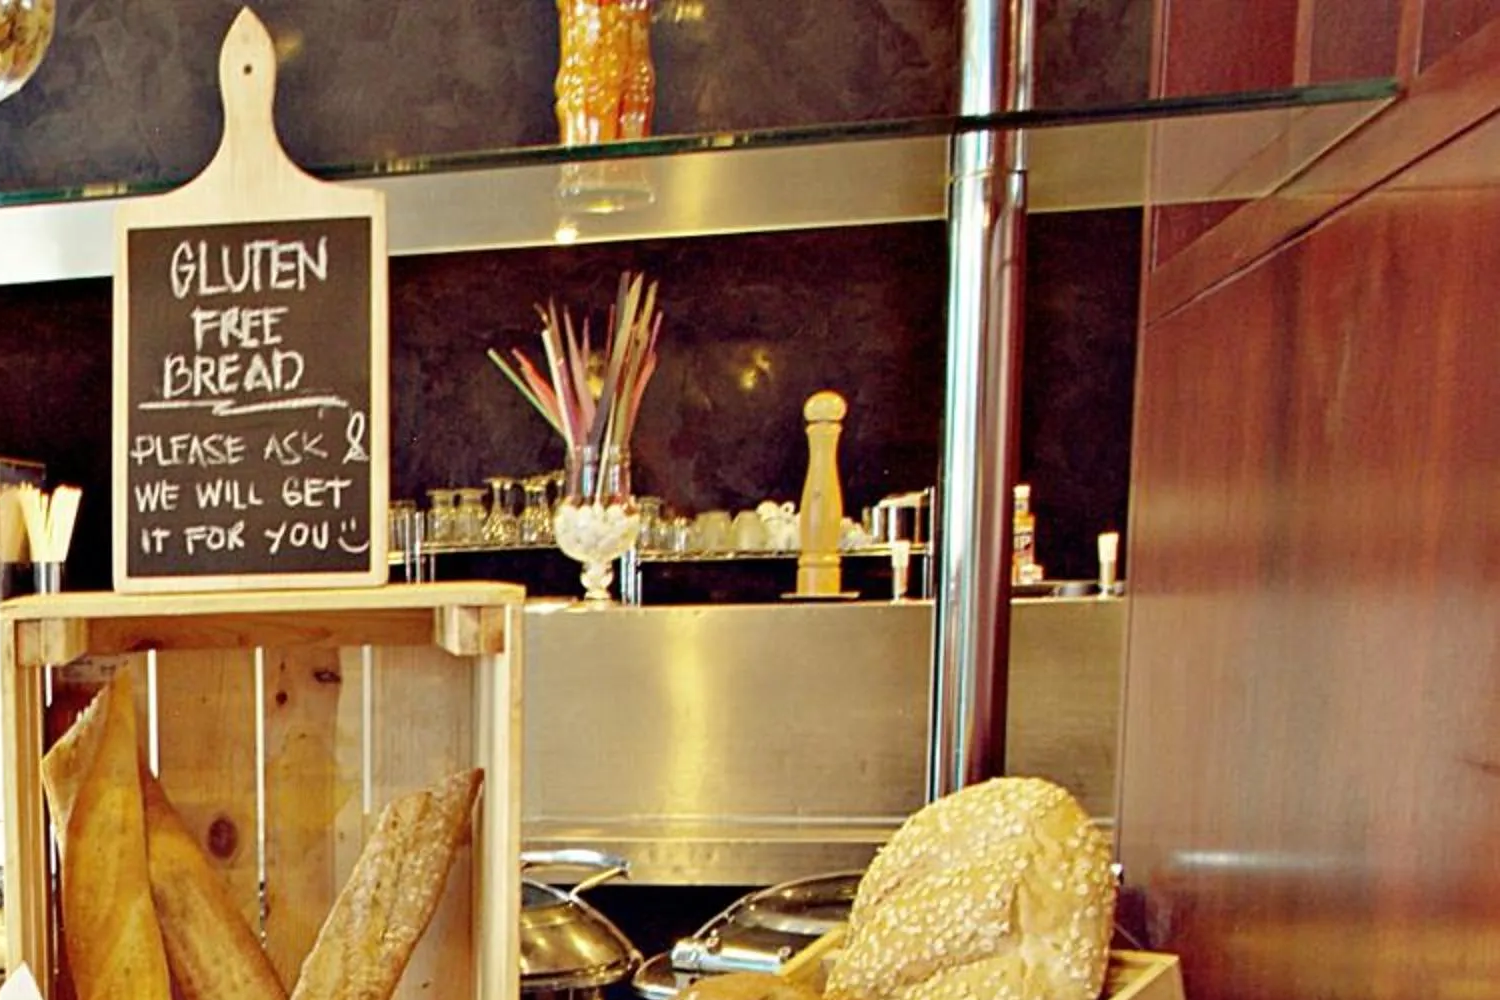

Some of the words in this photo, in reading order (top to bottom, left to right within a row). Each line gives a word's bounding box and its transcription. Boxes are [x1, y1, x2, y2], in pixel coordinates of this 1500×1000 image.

[170, 236, 328, 299] GLUTEN
[190, 305, 290, 350] FREE
[163, 350, 304, 399] BREAD
[130, 433, 245, 467] PLEASE
[263, 430, 329, 465] ASK
[134, 482, 180, 513] WE
[195, 479, 264, 510] WILL
[281, 476, 352, 509] GET
[141, 527, 171, 555] IT
[184, 521, 245, 555] FOR
[264, 520, 329, 555] YOU
